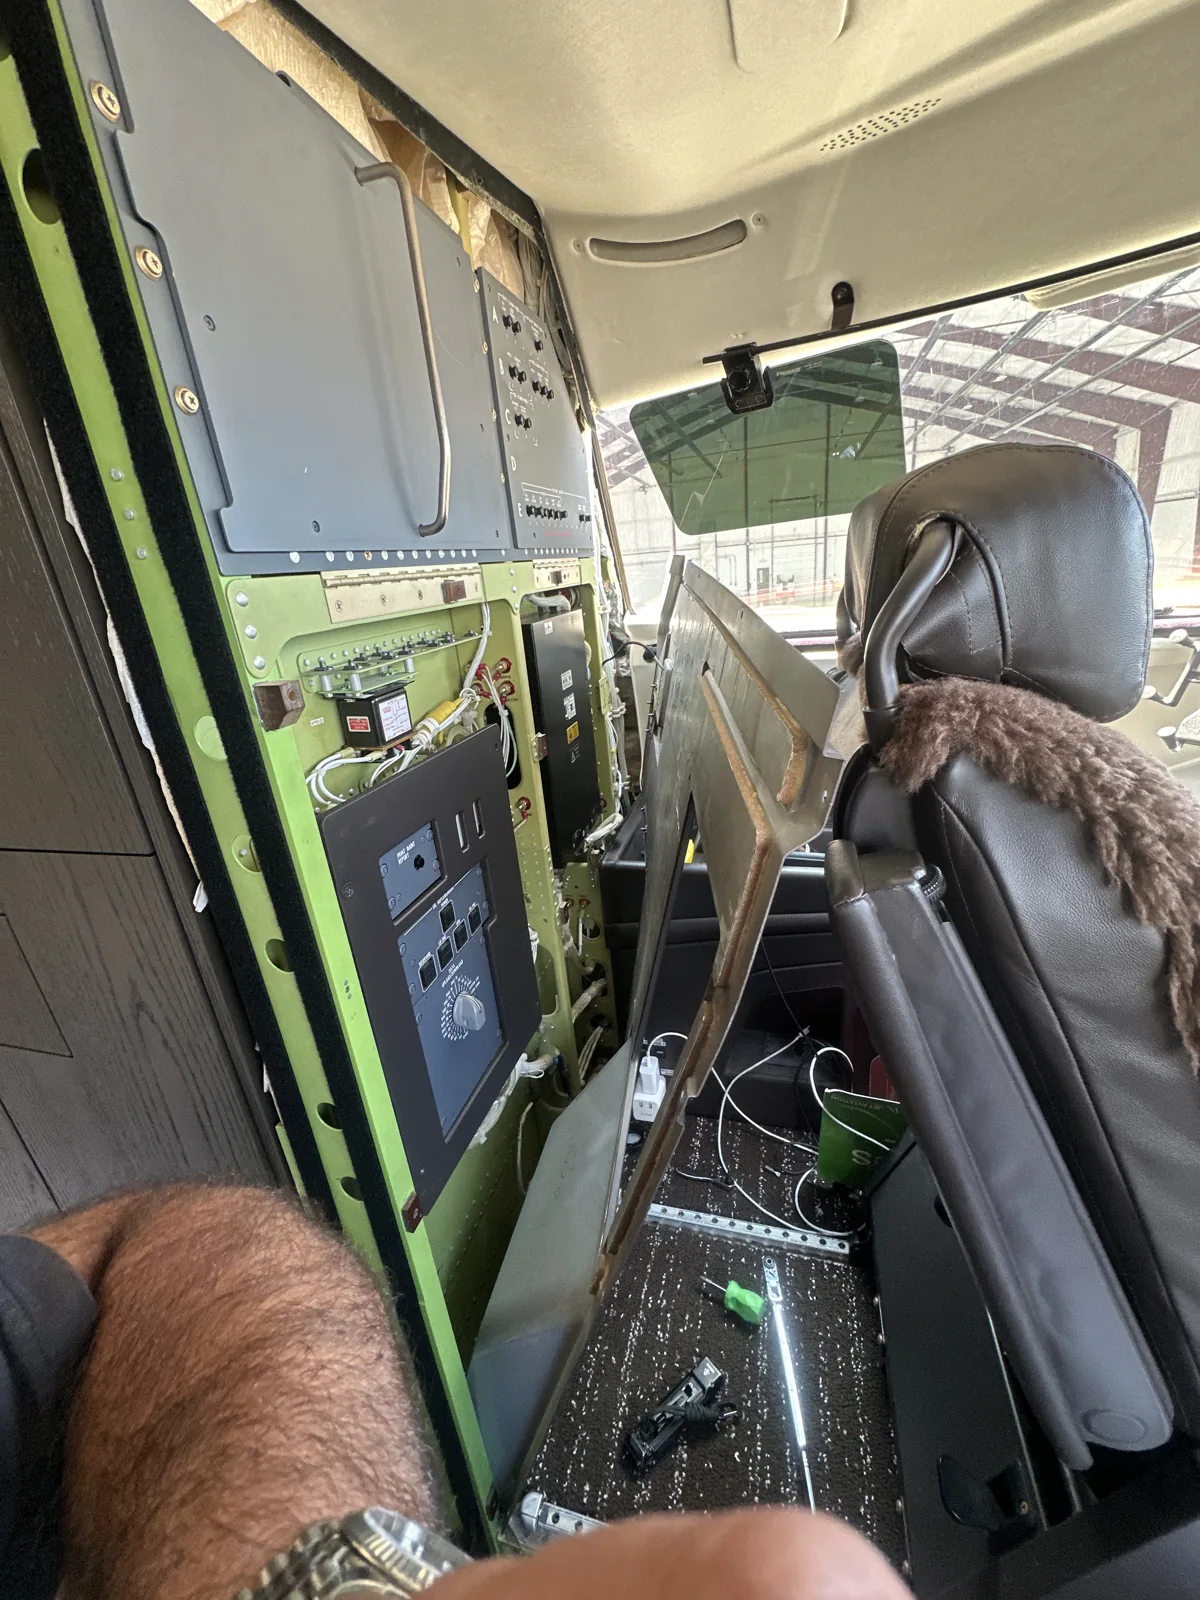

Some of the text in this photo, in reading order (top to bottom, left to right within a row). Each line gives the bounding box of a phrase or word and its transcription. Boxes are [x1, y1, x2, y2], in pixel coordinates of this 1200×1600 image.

[492, 305, 499, 325] A
[505, 408, 511, 425] C
[510, 455, 517, 471] D
